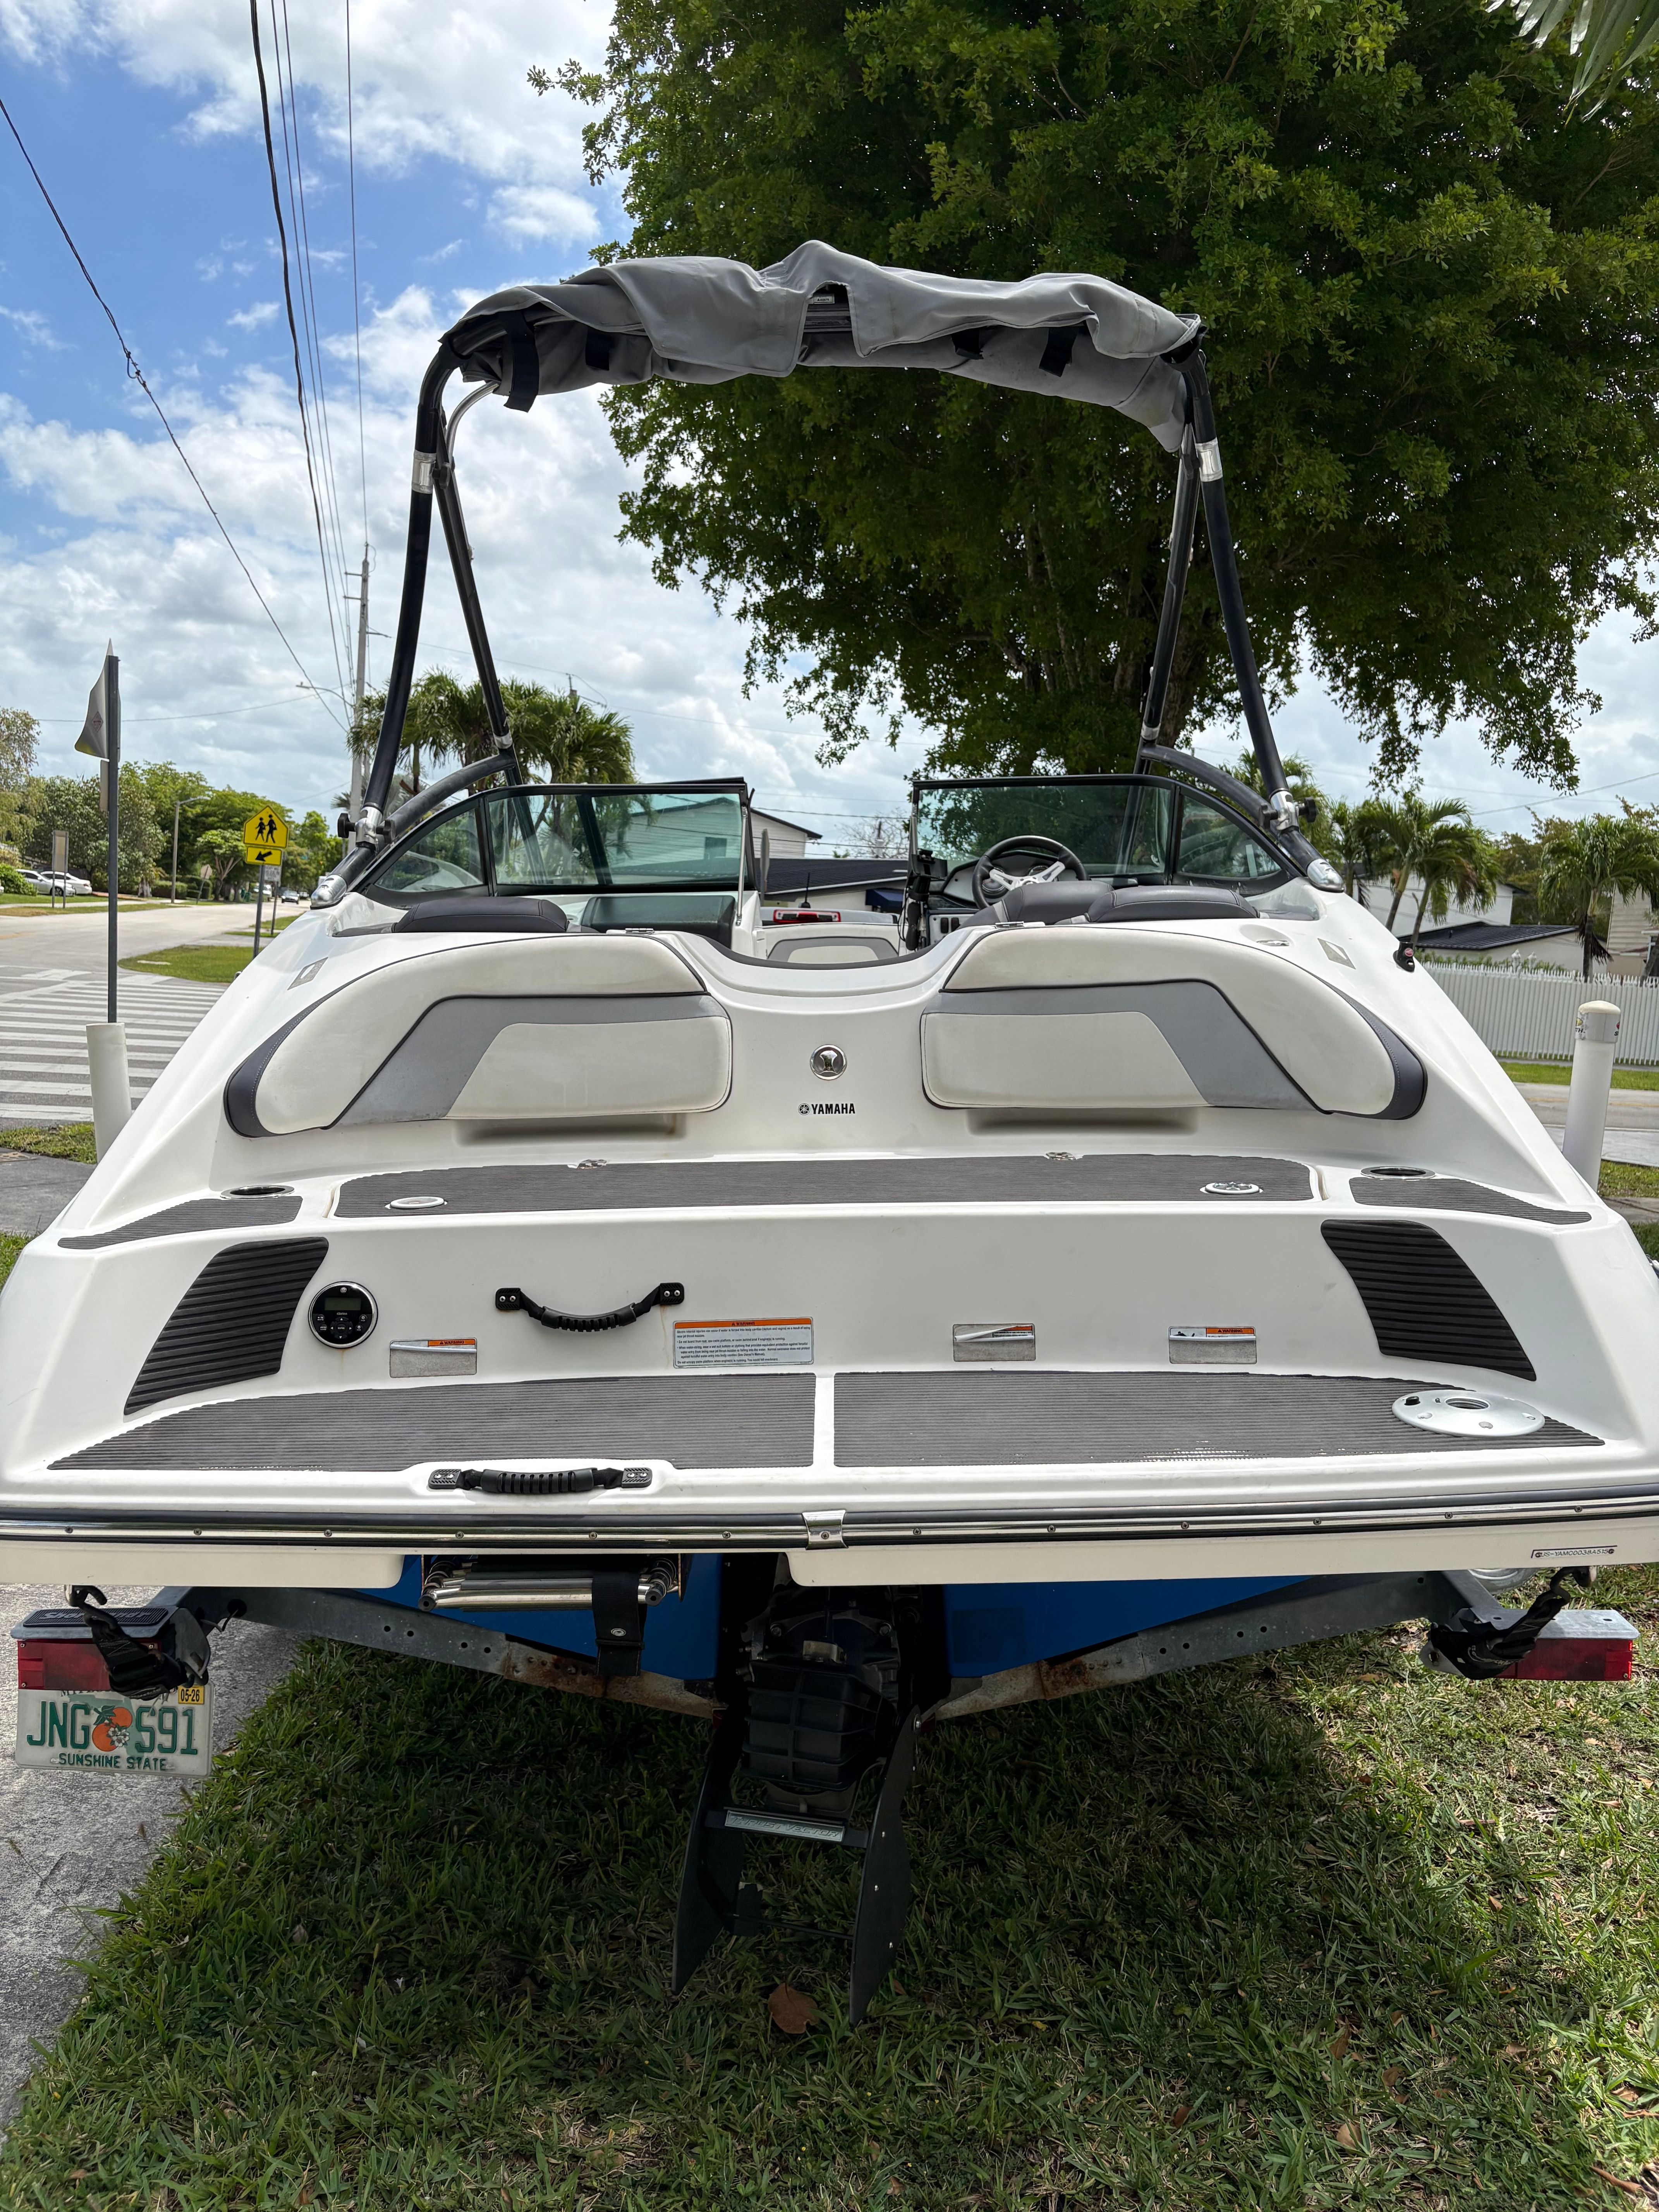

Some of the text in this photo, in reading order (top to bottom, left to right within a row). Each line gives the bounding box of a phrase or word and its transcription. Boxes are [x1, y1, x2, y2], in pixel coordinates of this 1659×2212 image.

[811, 1103, 855, 1114] YAMAHA
[181, 1689, 199, 1702] 05-26
[27, 1701, 89, 1749] JNG
[58, 1753, 167, 1771] SUNSHINE STATE
